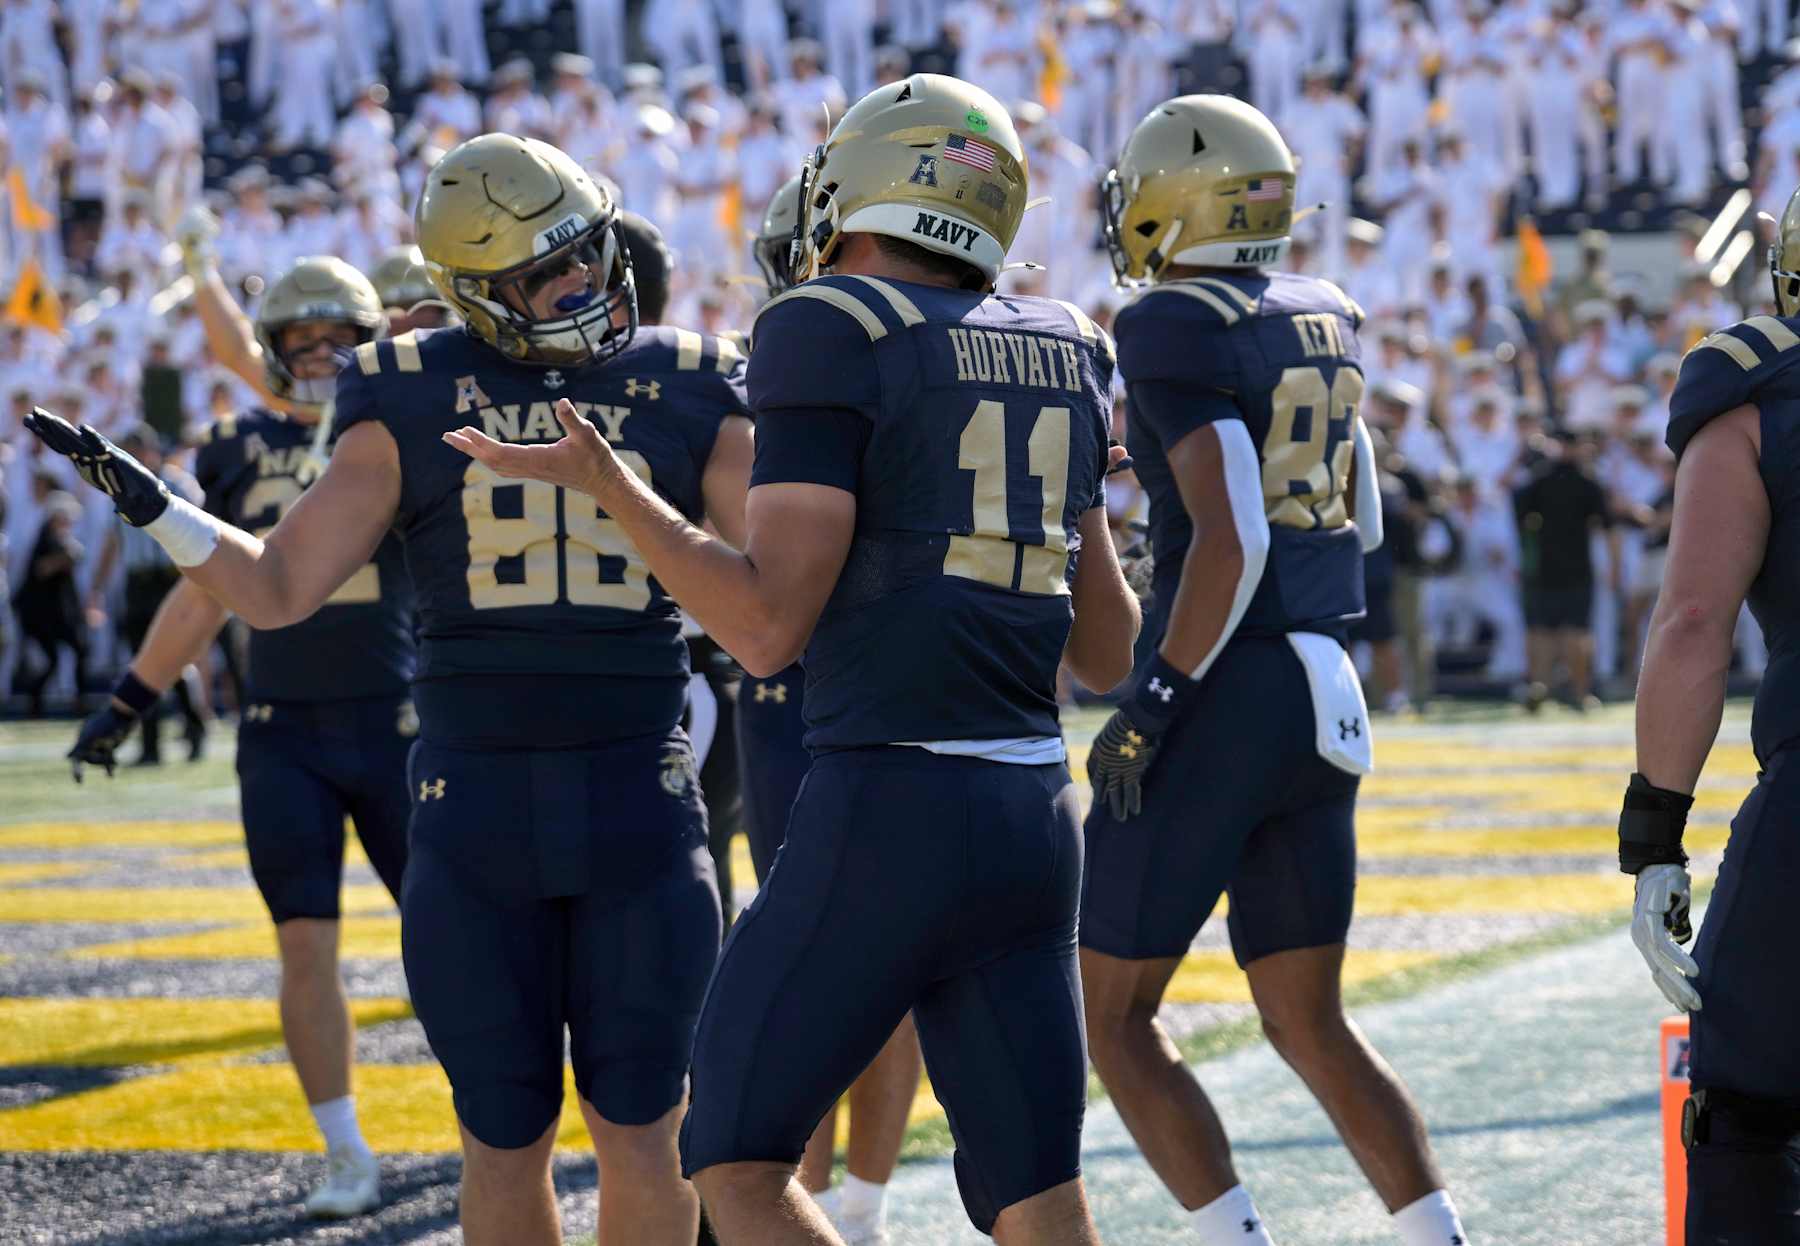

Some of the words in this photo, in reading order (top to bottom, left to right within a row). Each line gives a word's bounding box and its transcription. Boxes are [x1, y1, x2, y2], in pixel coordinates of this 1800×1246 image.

[543, 218, 580, 249] NAVY
[912, 212, 980, 252] NAVY
[1233, 244, 1280, 264] NAVY
[948, 327, 1083, 393] HORVATH
[943, 399, 1073, 597] 11
